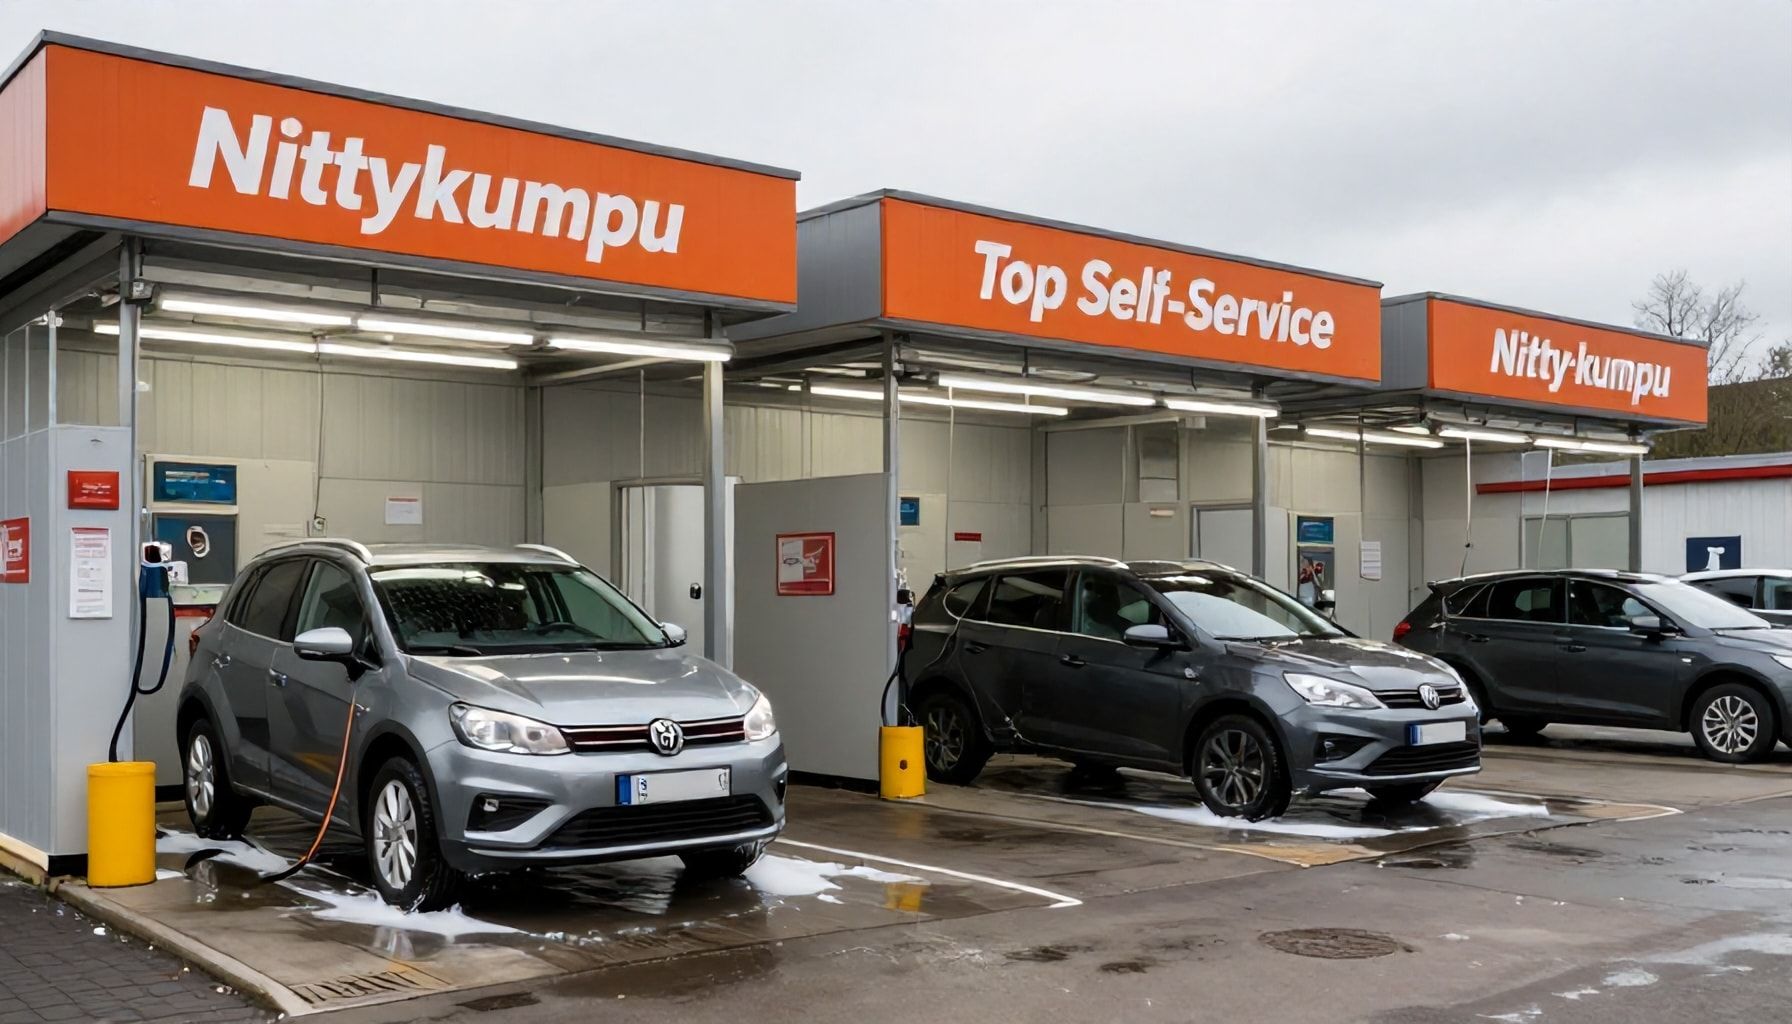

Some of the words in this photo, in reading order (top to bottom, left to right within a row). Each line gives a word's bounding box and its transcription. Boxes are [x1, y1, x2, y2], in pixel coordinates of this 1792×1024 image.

[189, 106, 685, 263] Nittykumpu
[974, 240, 1068, 322] Top
[1077, 259, 1335, 349] Self-Service
